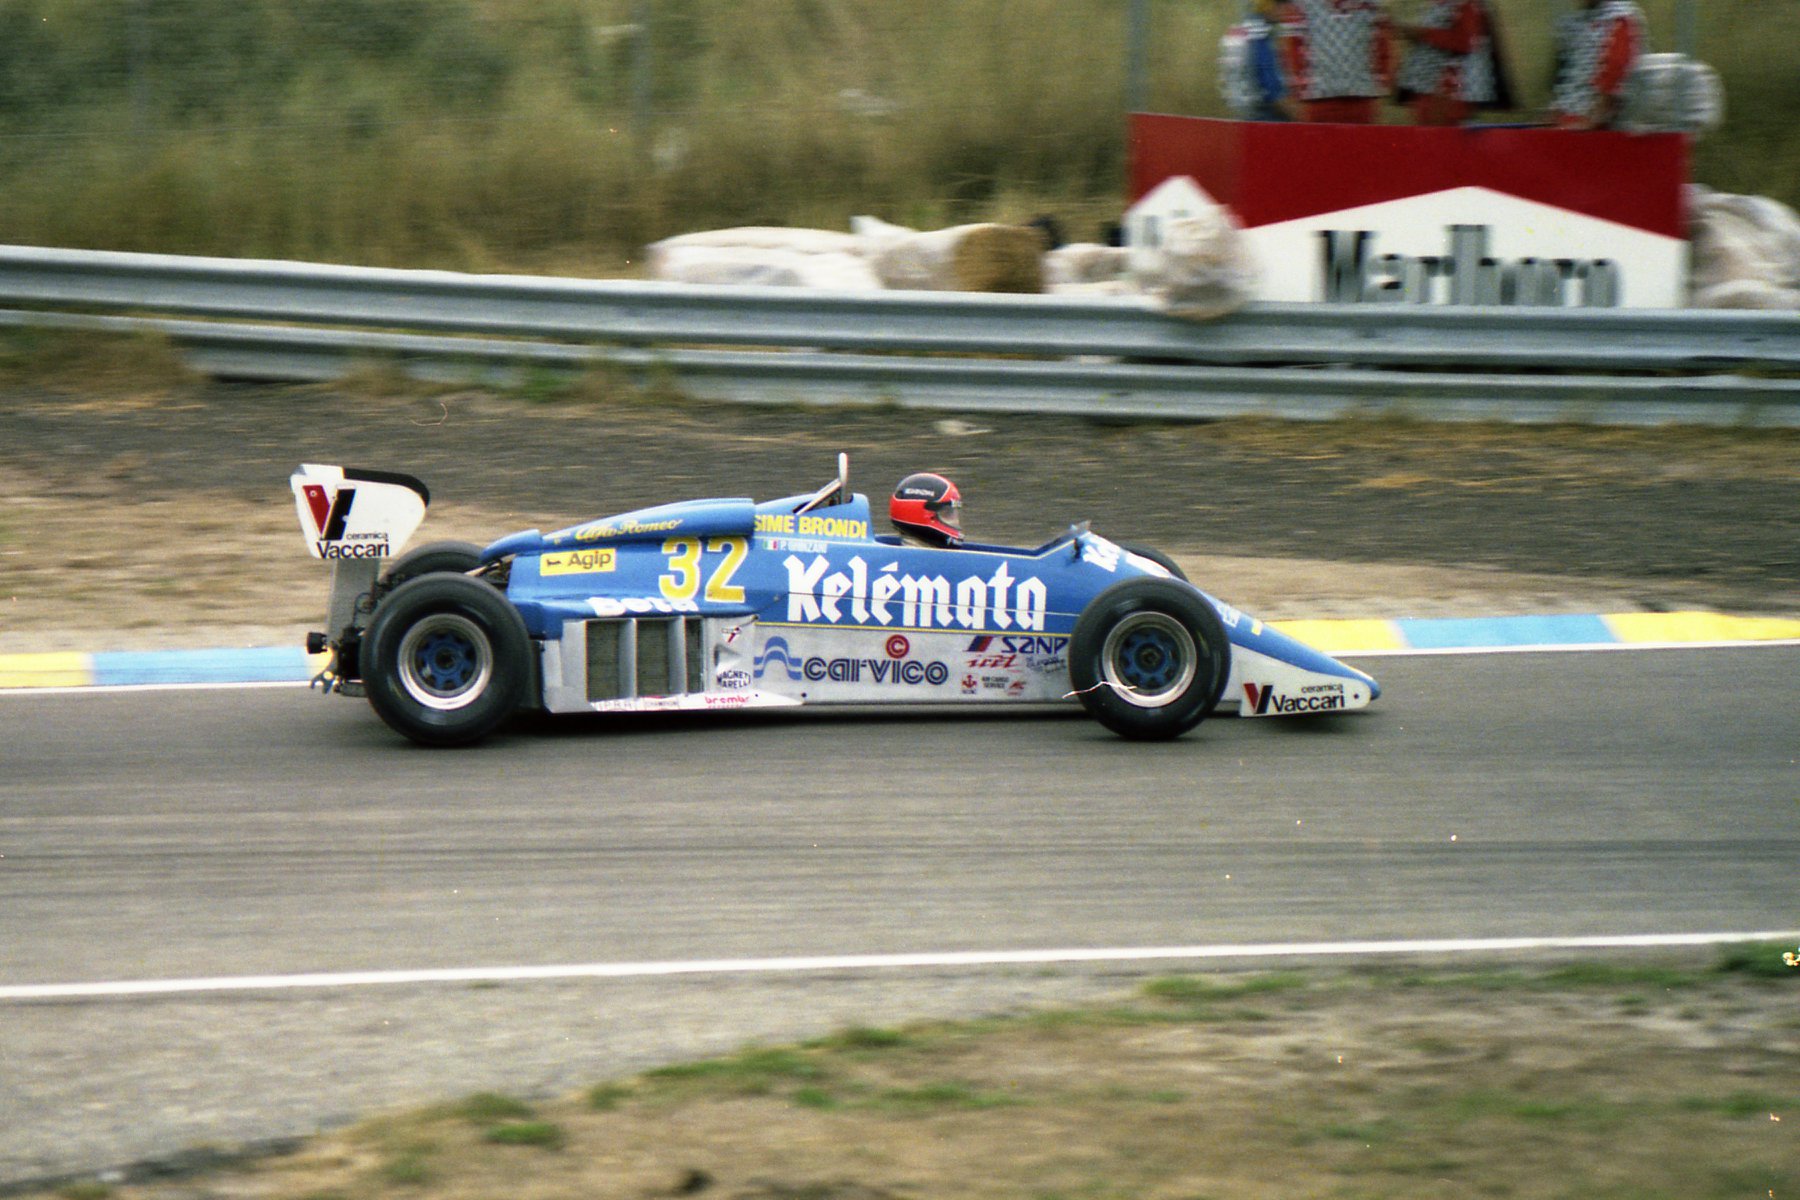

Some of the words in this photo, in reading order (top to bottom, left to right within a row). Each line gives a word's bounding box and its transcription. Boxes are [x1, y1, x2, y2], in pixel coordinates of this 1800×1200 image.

[346, 532, 389, 540] ceramica
[798, 516, 868, 539] BRONDI
[316, 539, 390, 559] Vaccari
[567, 550, 612, 569] Agip
[659, 536, 749, 604] 32
[783, 554, 1047, 631] Kelémata
[804, 656, 949, 686] carvico
[1301, 683, 1344, 694] ceramica
[1272, 690, 1345, 712] Vaccari
